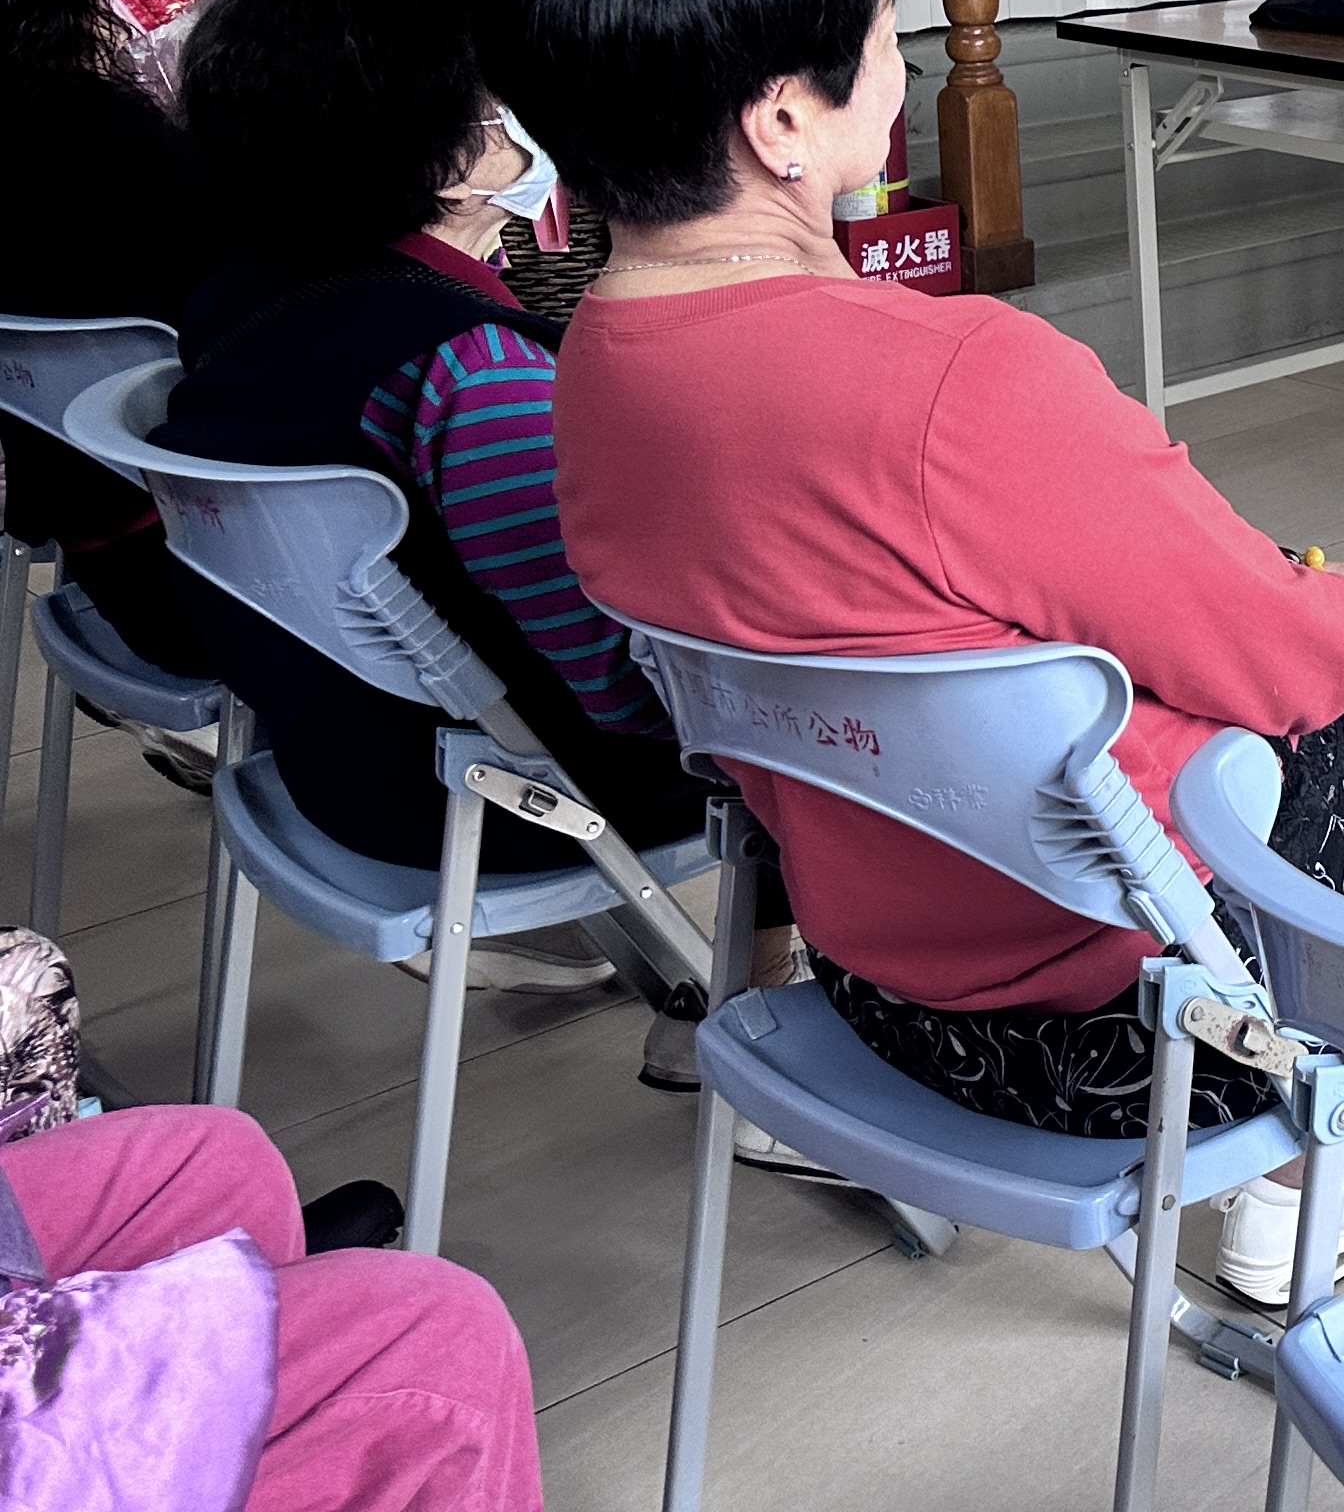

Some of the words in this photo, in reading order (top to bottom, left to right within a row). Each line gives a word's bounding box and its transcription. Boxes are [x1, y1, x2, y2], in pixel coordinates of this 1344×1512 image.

[861, 229, 951, 273] 滅火器
[885, 261, 952, 282] EXTINGUISHER
